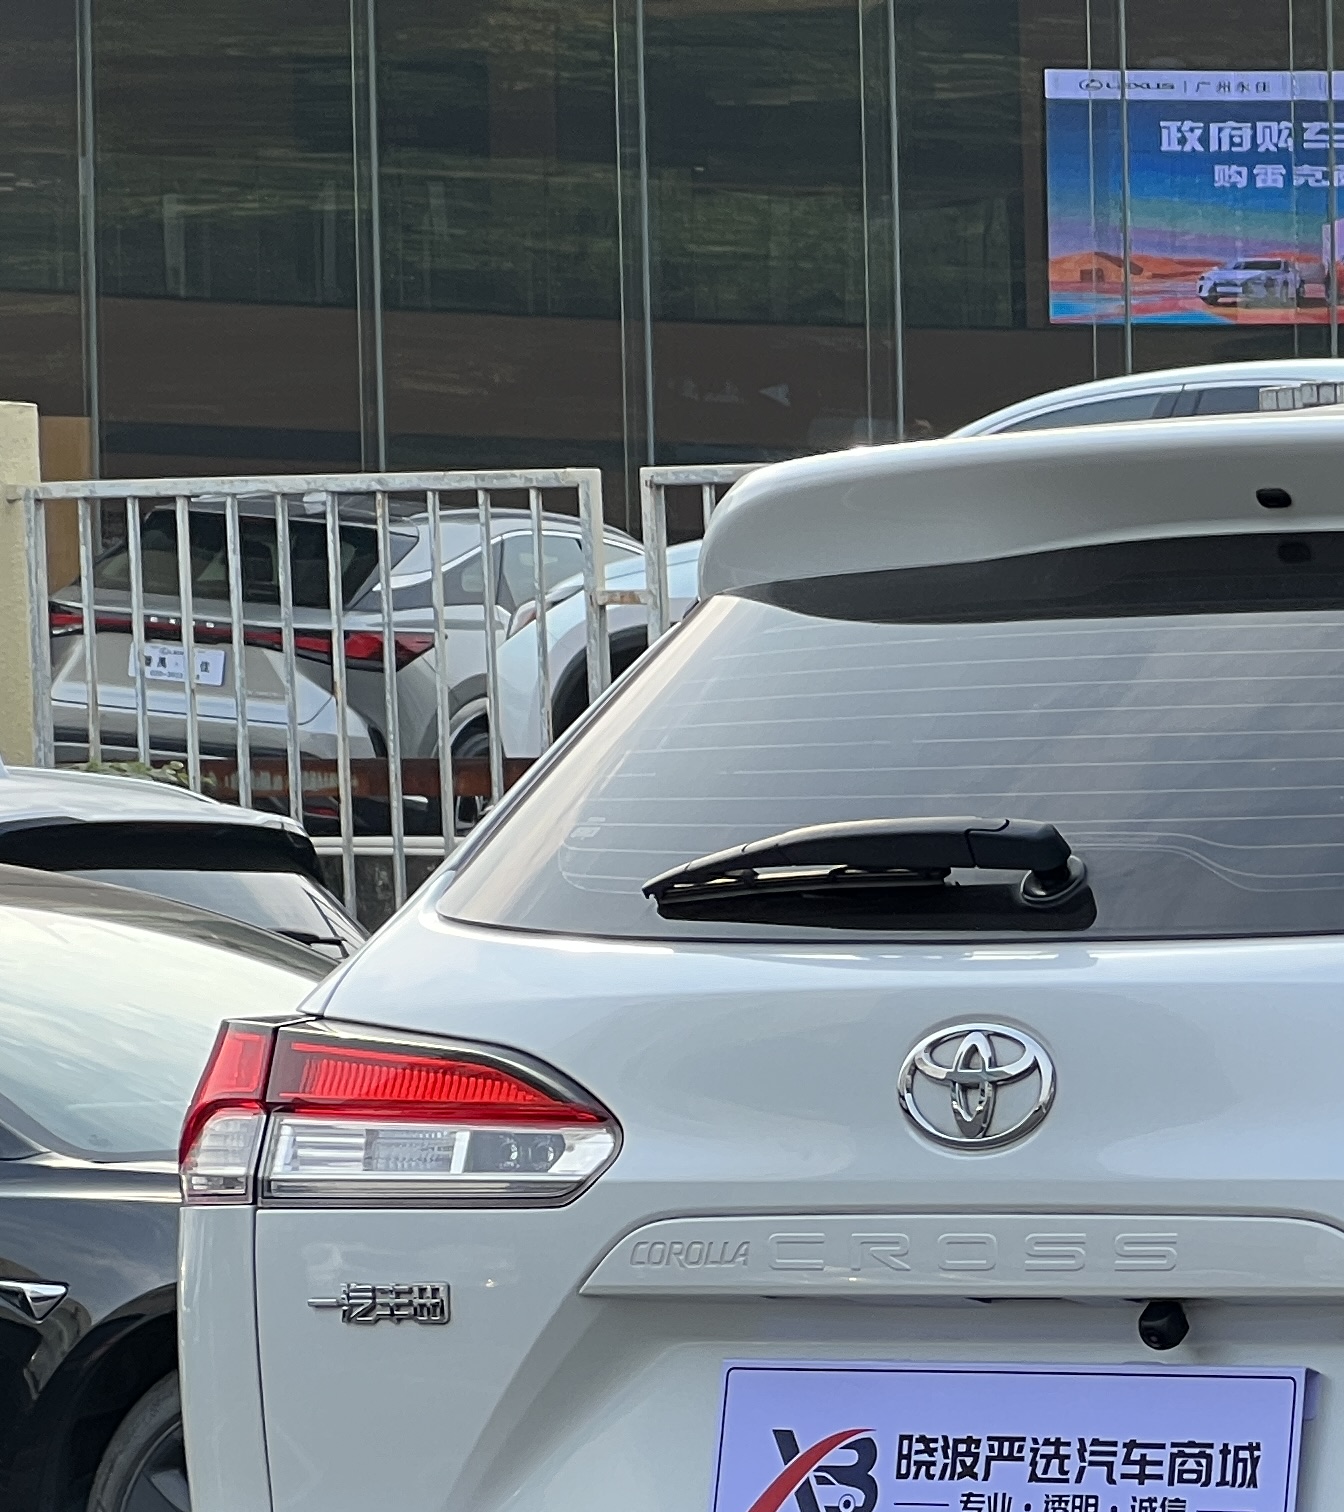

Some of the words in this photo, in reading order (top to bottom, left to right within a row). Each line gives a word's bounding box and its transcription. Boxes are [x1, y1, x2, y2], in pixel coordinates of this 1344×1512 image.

[630, 1241, 751, 1267] COROLLA
[767, 1232, 1179, 1272] CROSS
[307, 1282, 450, 1325] 一汽丰田
[895, 1433, 1262, 1489] 晓波严选汽车商城
